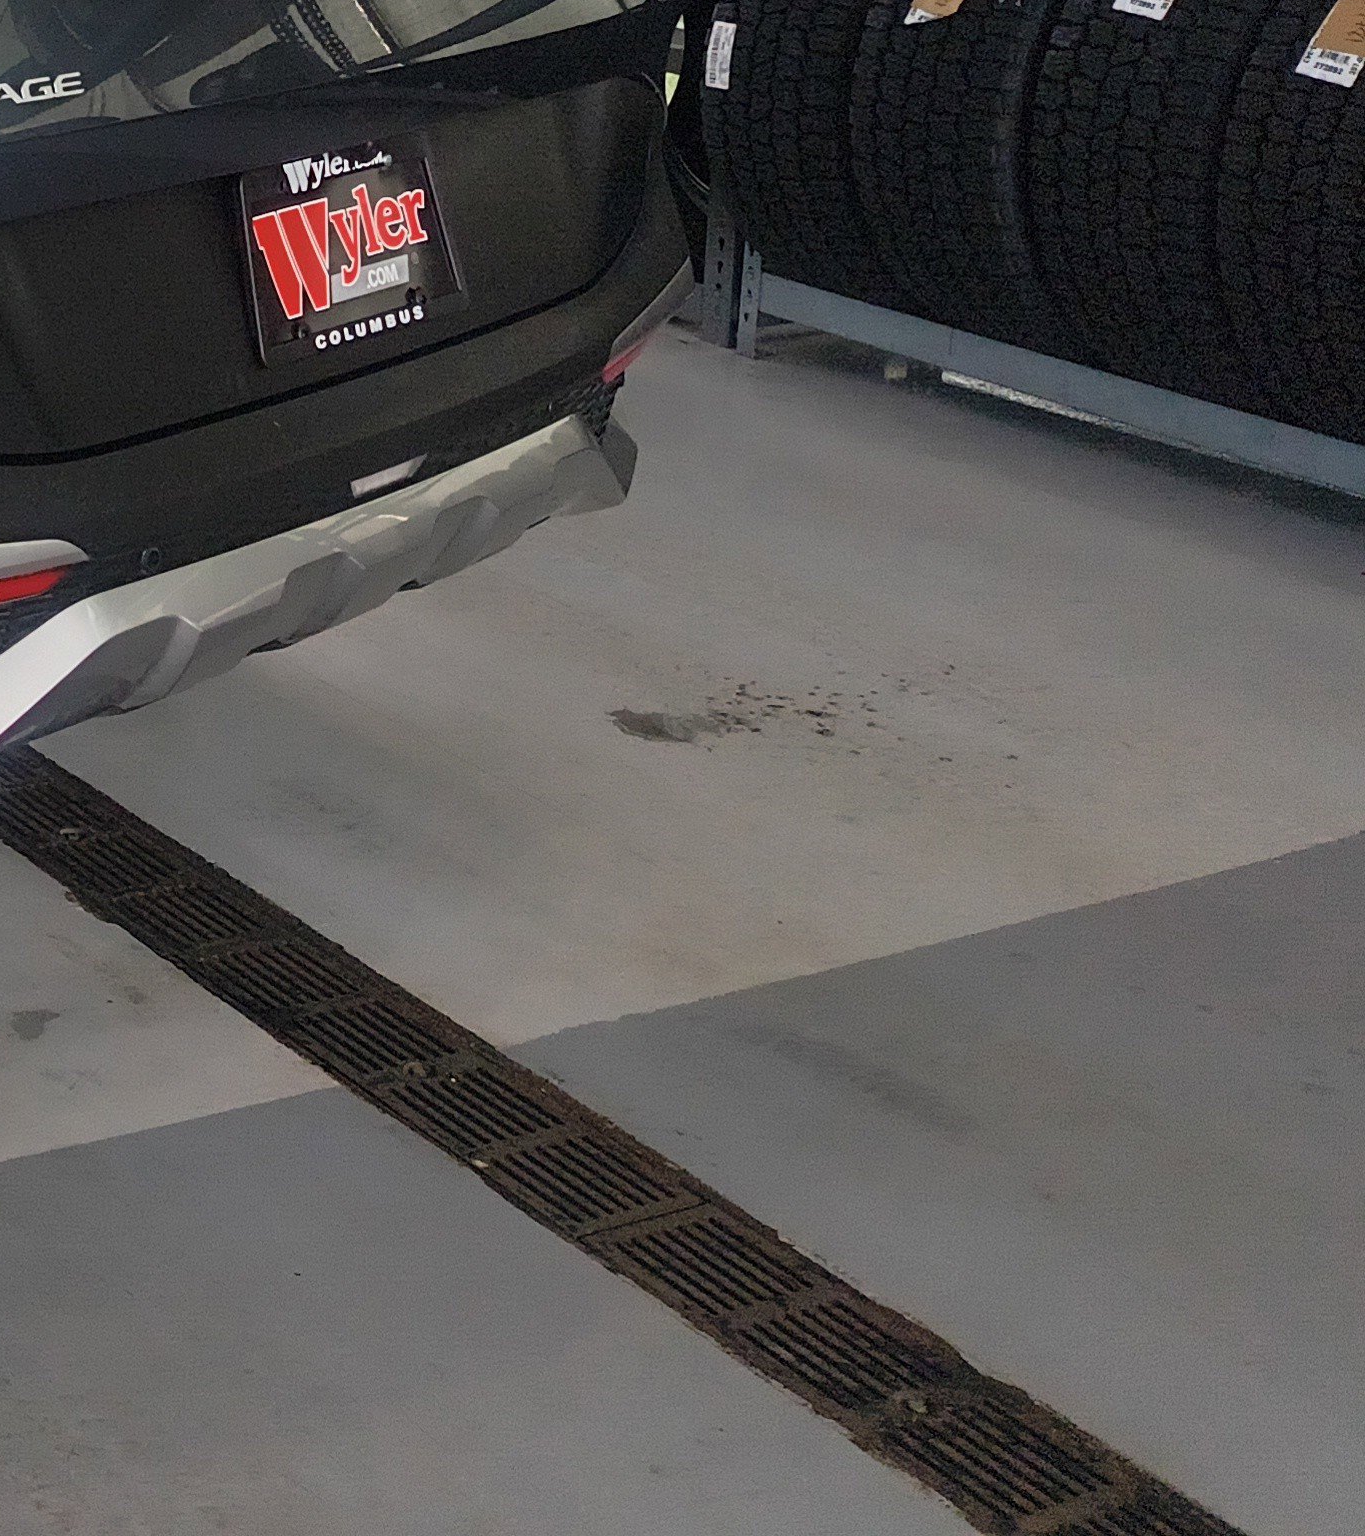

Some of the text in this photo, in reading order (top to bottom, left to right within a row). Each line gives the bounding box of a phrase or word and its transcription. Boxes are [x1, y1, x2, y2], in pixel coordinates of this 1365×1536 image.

[252, 183, 428, 320] Wyler
[366, 264, 399, 288] .COM
[315, 305, 424, 349] COLUMBUS
